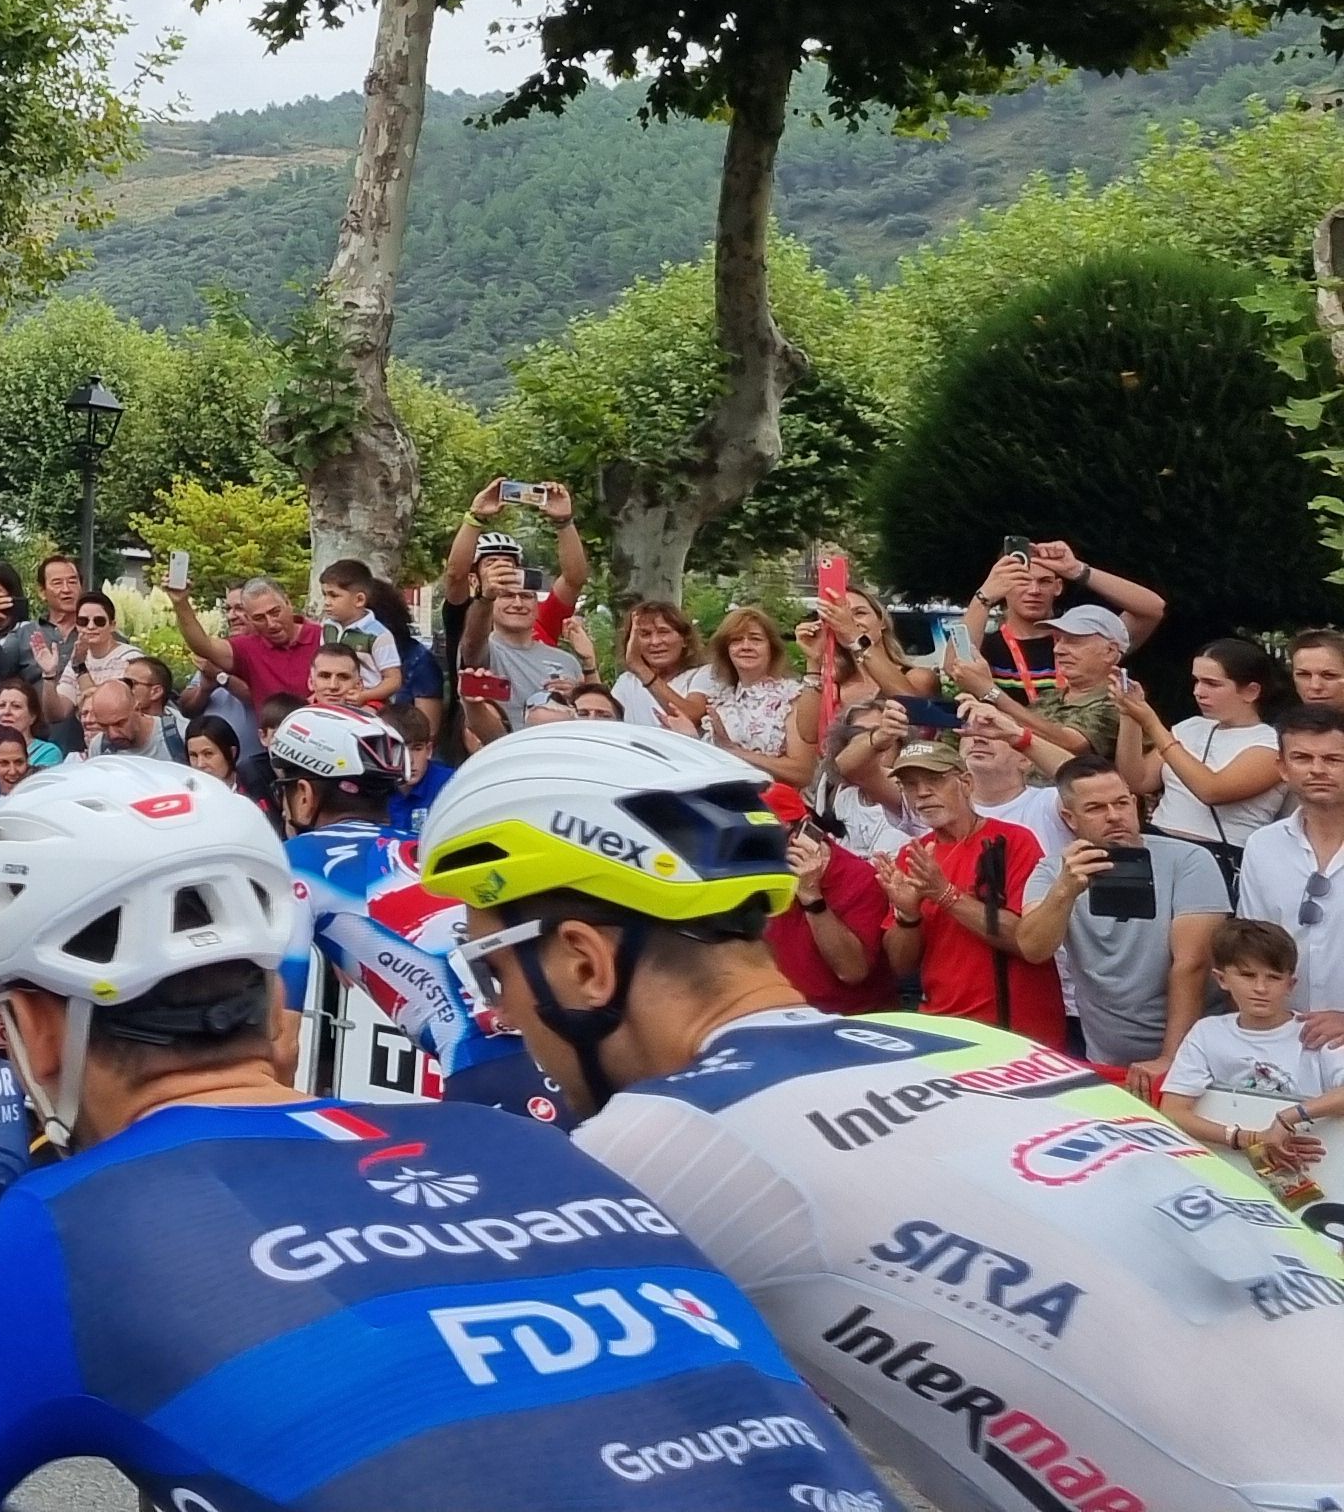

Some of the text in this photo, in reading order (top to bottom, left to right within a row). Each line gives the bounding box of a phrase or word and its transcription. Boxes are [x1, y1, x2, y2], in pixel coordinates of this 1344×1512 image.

[550, 809, 650, 869] uvex
[250, 1197, 680, 1282] Groupama
[869, 1219, 1089, 1338] SITRA
[427, 1288, 656, 1386] FDJ
